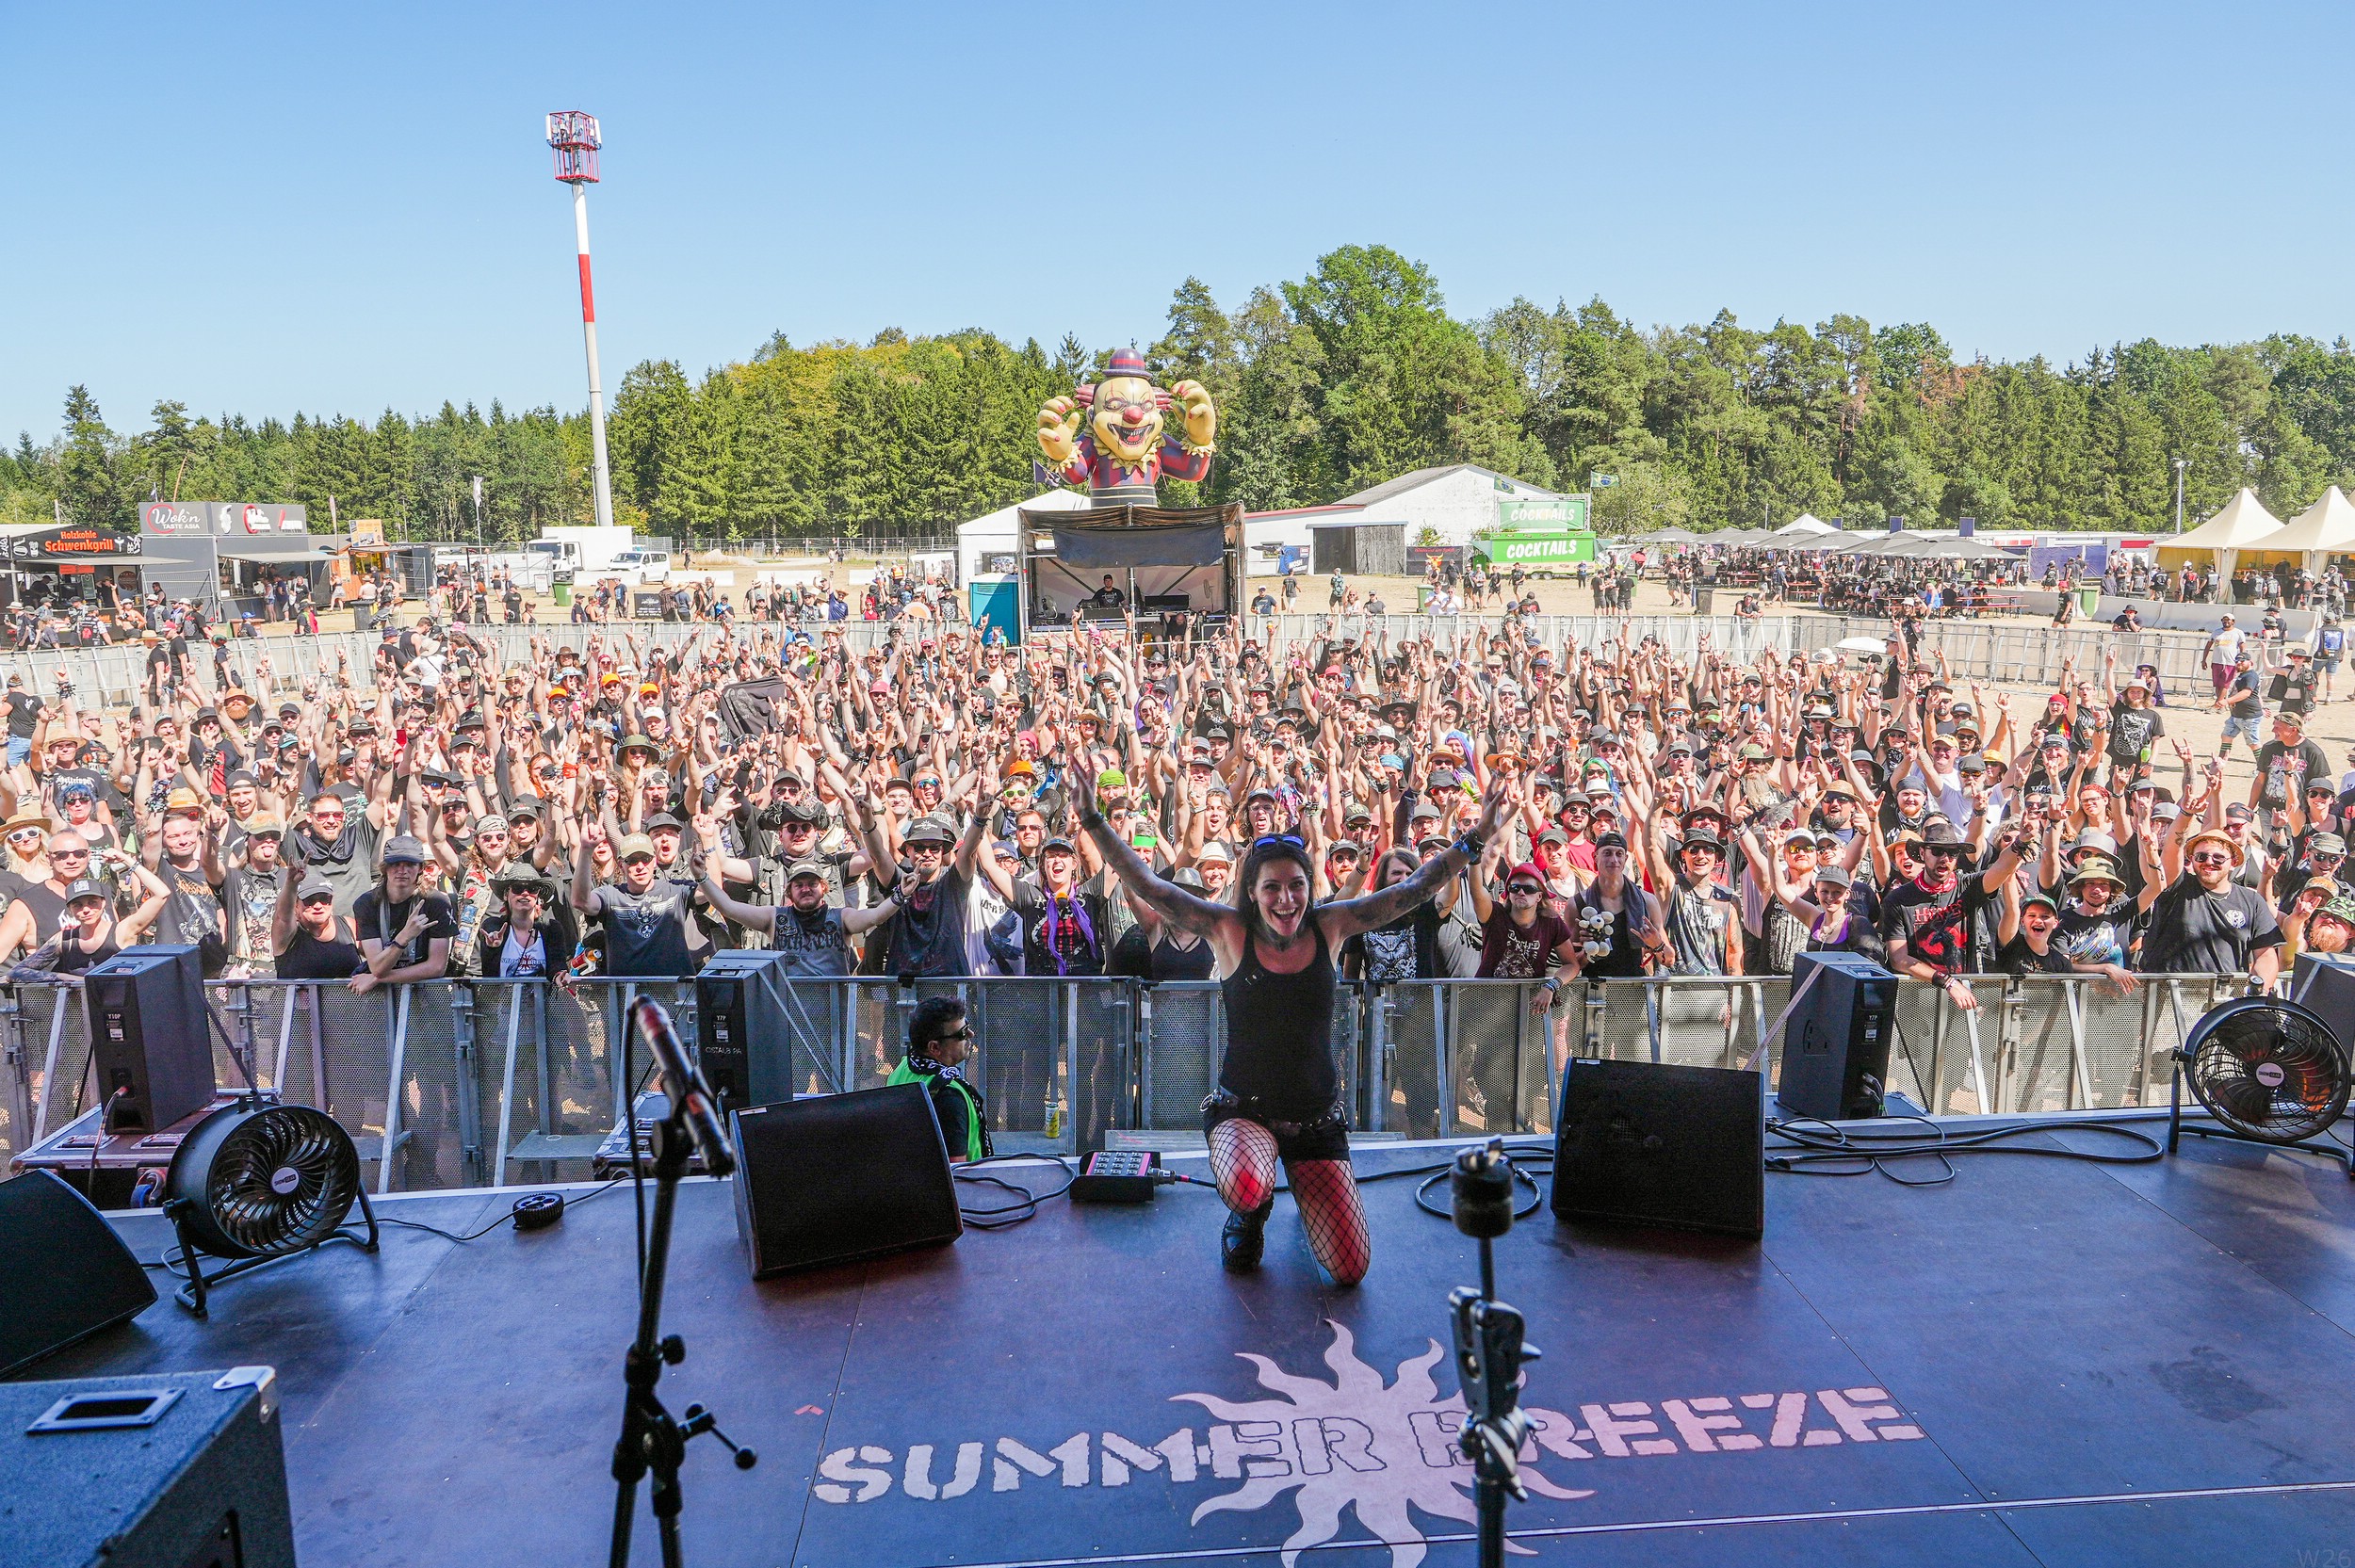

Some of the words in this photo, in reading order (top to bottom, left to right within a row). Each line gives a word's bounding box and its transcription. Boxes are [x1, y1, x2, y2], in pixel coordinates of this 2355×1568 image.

[1511, 509, 1575, 522] COCKTAILS
[60, 530, 97, 540] Holzkohle
[44, 539, 115, 554] Schwenkgrill
[1507, 540, 1577, 559] COCKTAILS
[814, 1416, 1388, 1504] SUMMER
